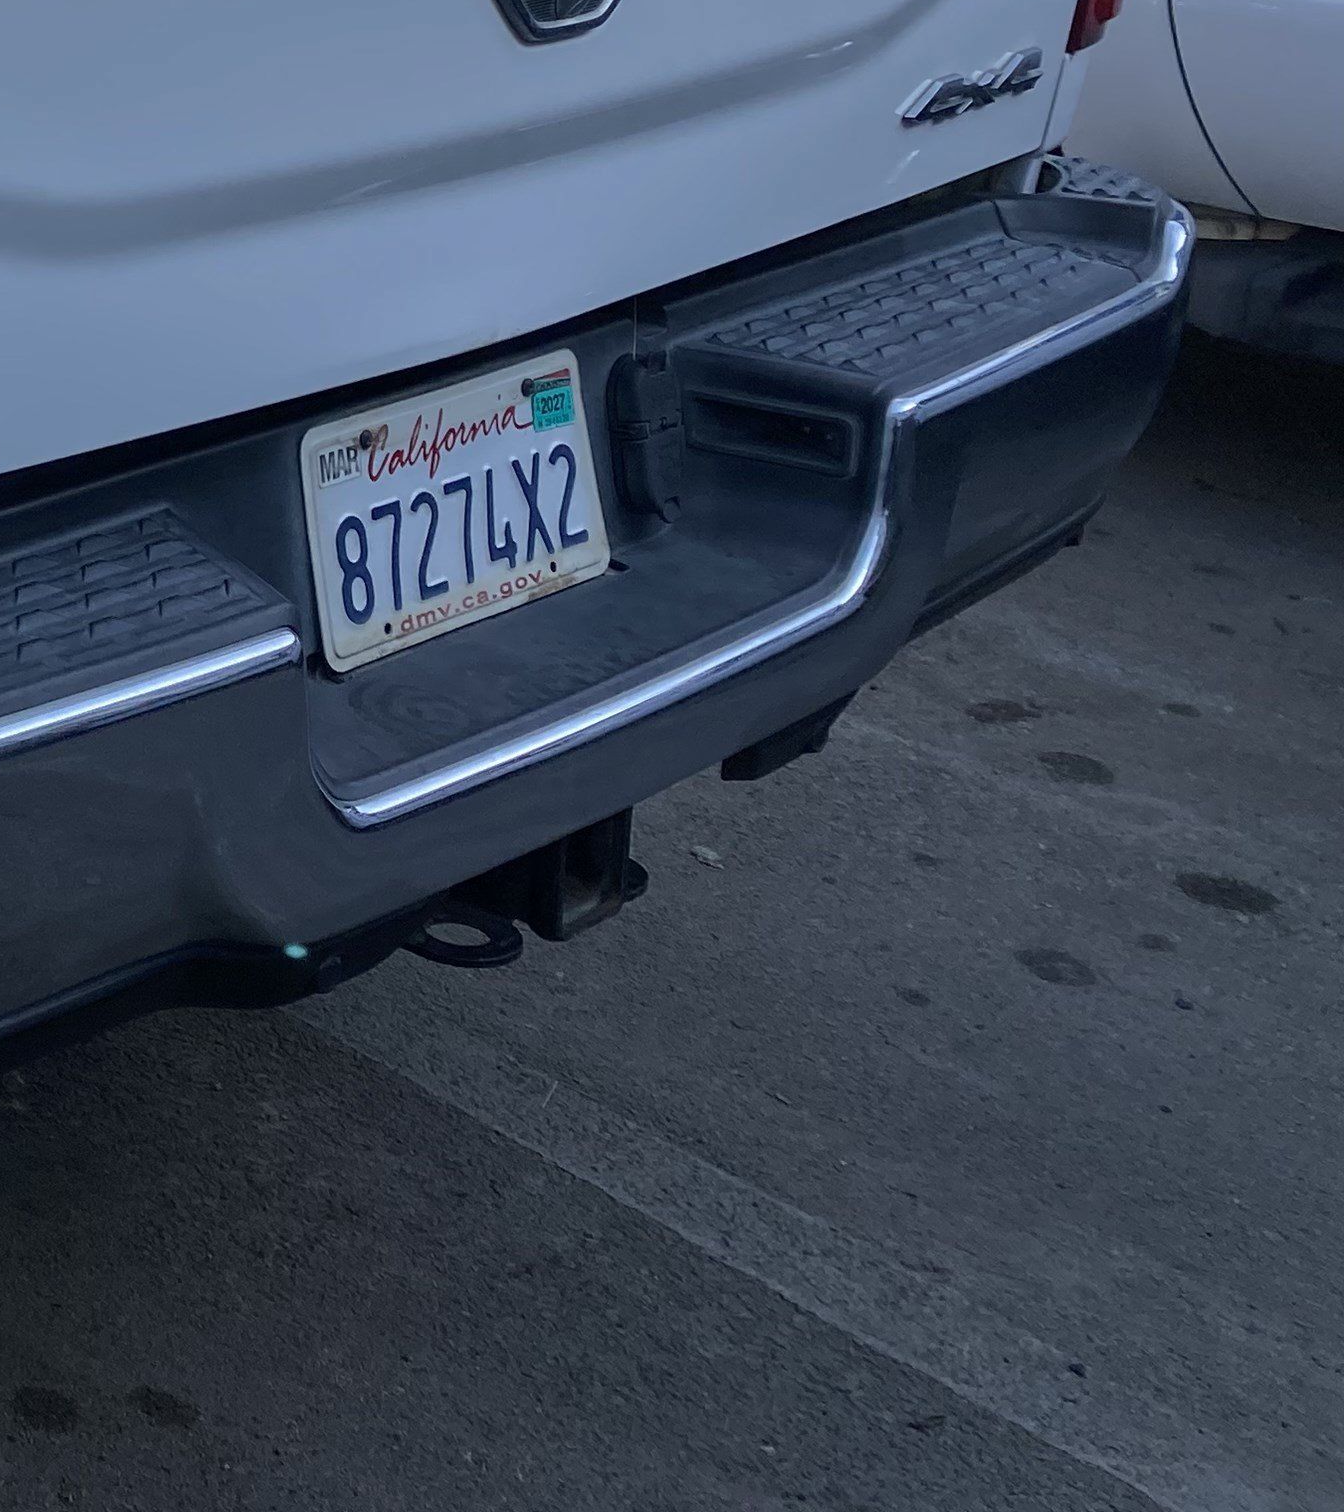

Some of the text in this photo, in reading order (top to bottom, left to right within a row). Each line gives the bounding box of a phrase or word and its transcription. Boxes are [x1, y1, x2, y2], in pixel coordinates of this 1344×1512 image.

[319, 394, 533, 484] MAR California
[540, 393, 566, 415] 2027
[335, 443, 589, 625] 87274X2
[400, 569, 543, 635] dmv.ca.gov
